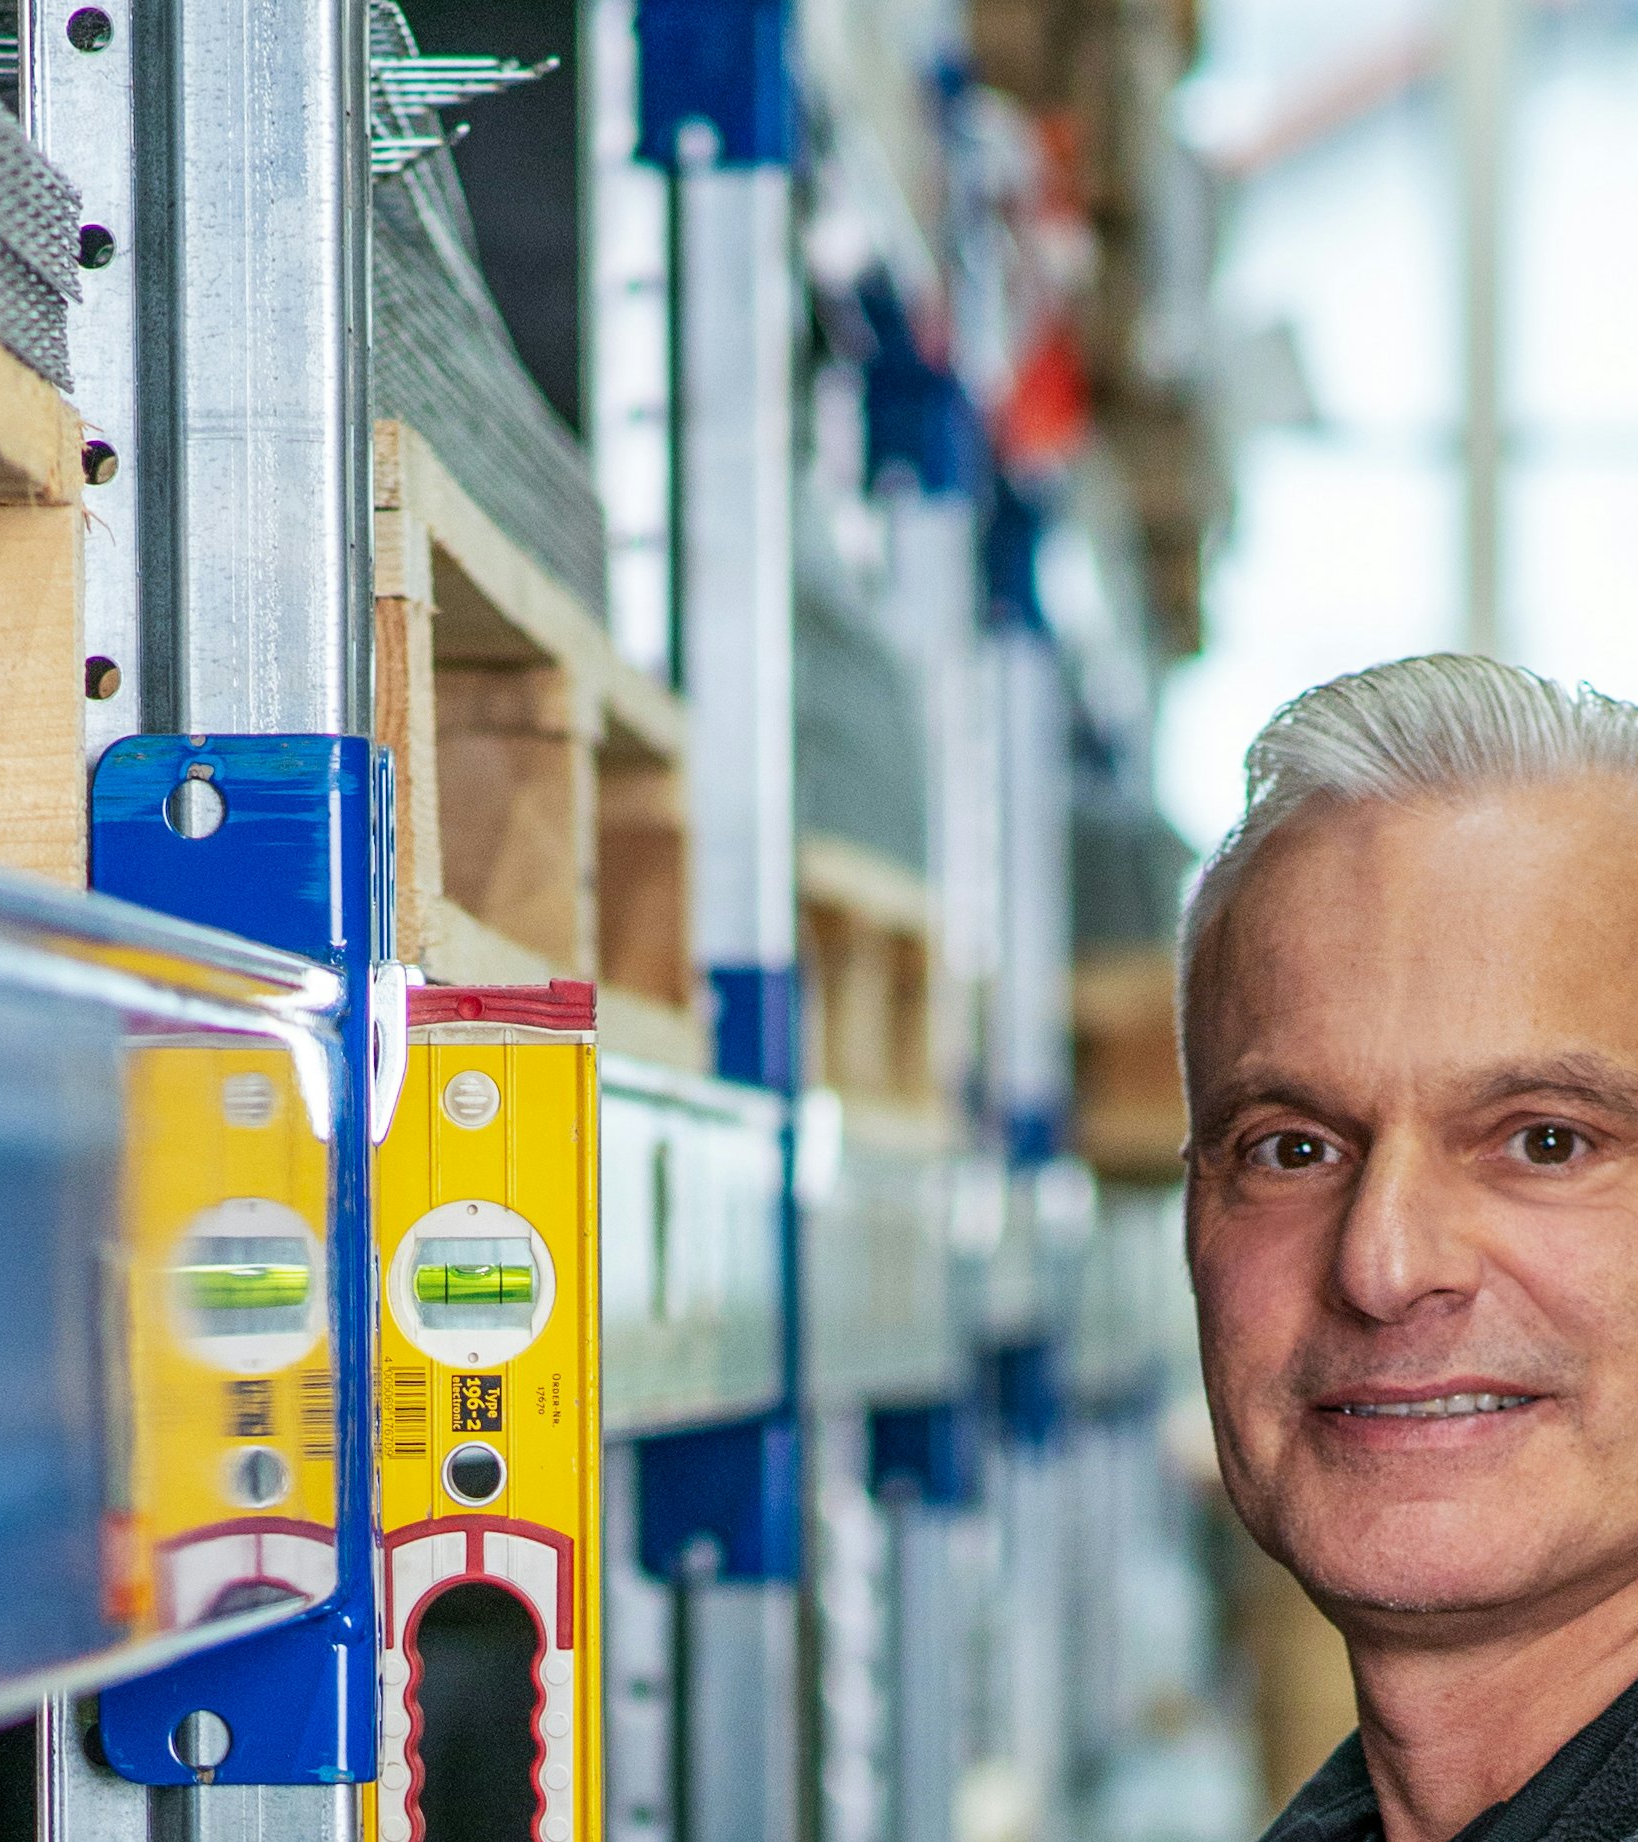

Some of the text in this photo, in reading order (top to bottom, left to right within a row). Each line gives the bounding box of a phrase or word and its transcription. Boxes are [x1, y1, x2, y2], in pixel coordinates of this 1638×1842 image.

[384, 1370, 393, 1410] 005069
[452, 1377, 462, 1429] electronic
[463, 1377, 484, 1430] 196-2
[485, 1387, 500, 1418] Type
[537, 1386, 545, 1415] 17670
[384, 1418, 393, 1456] 176709
